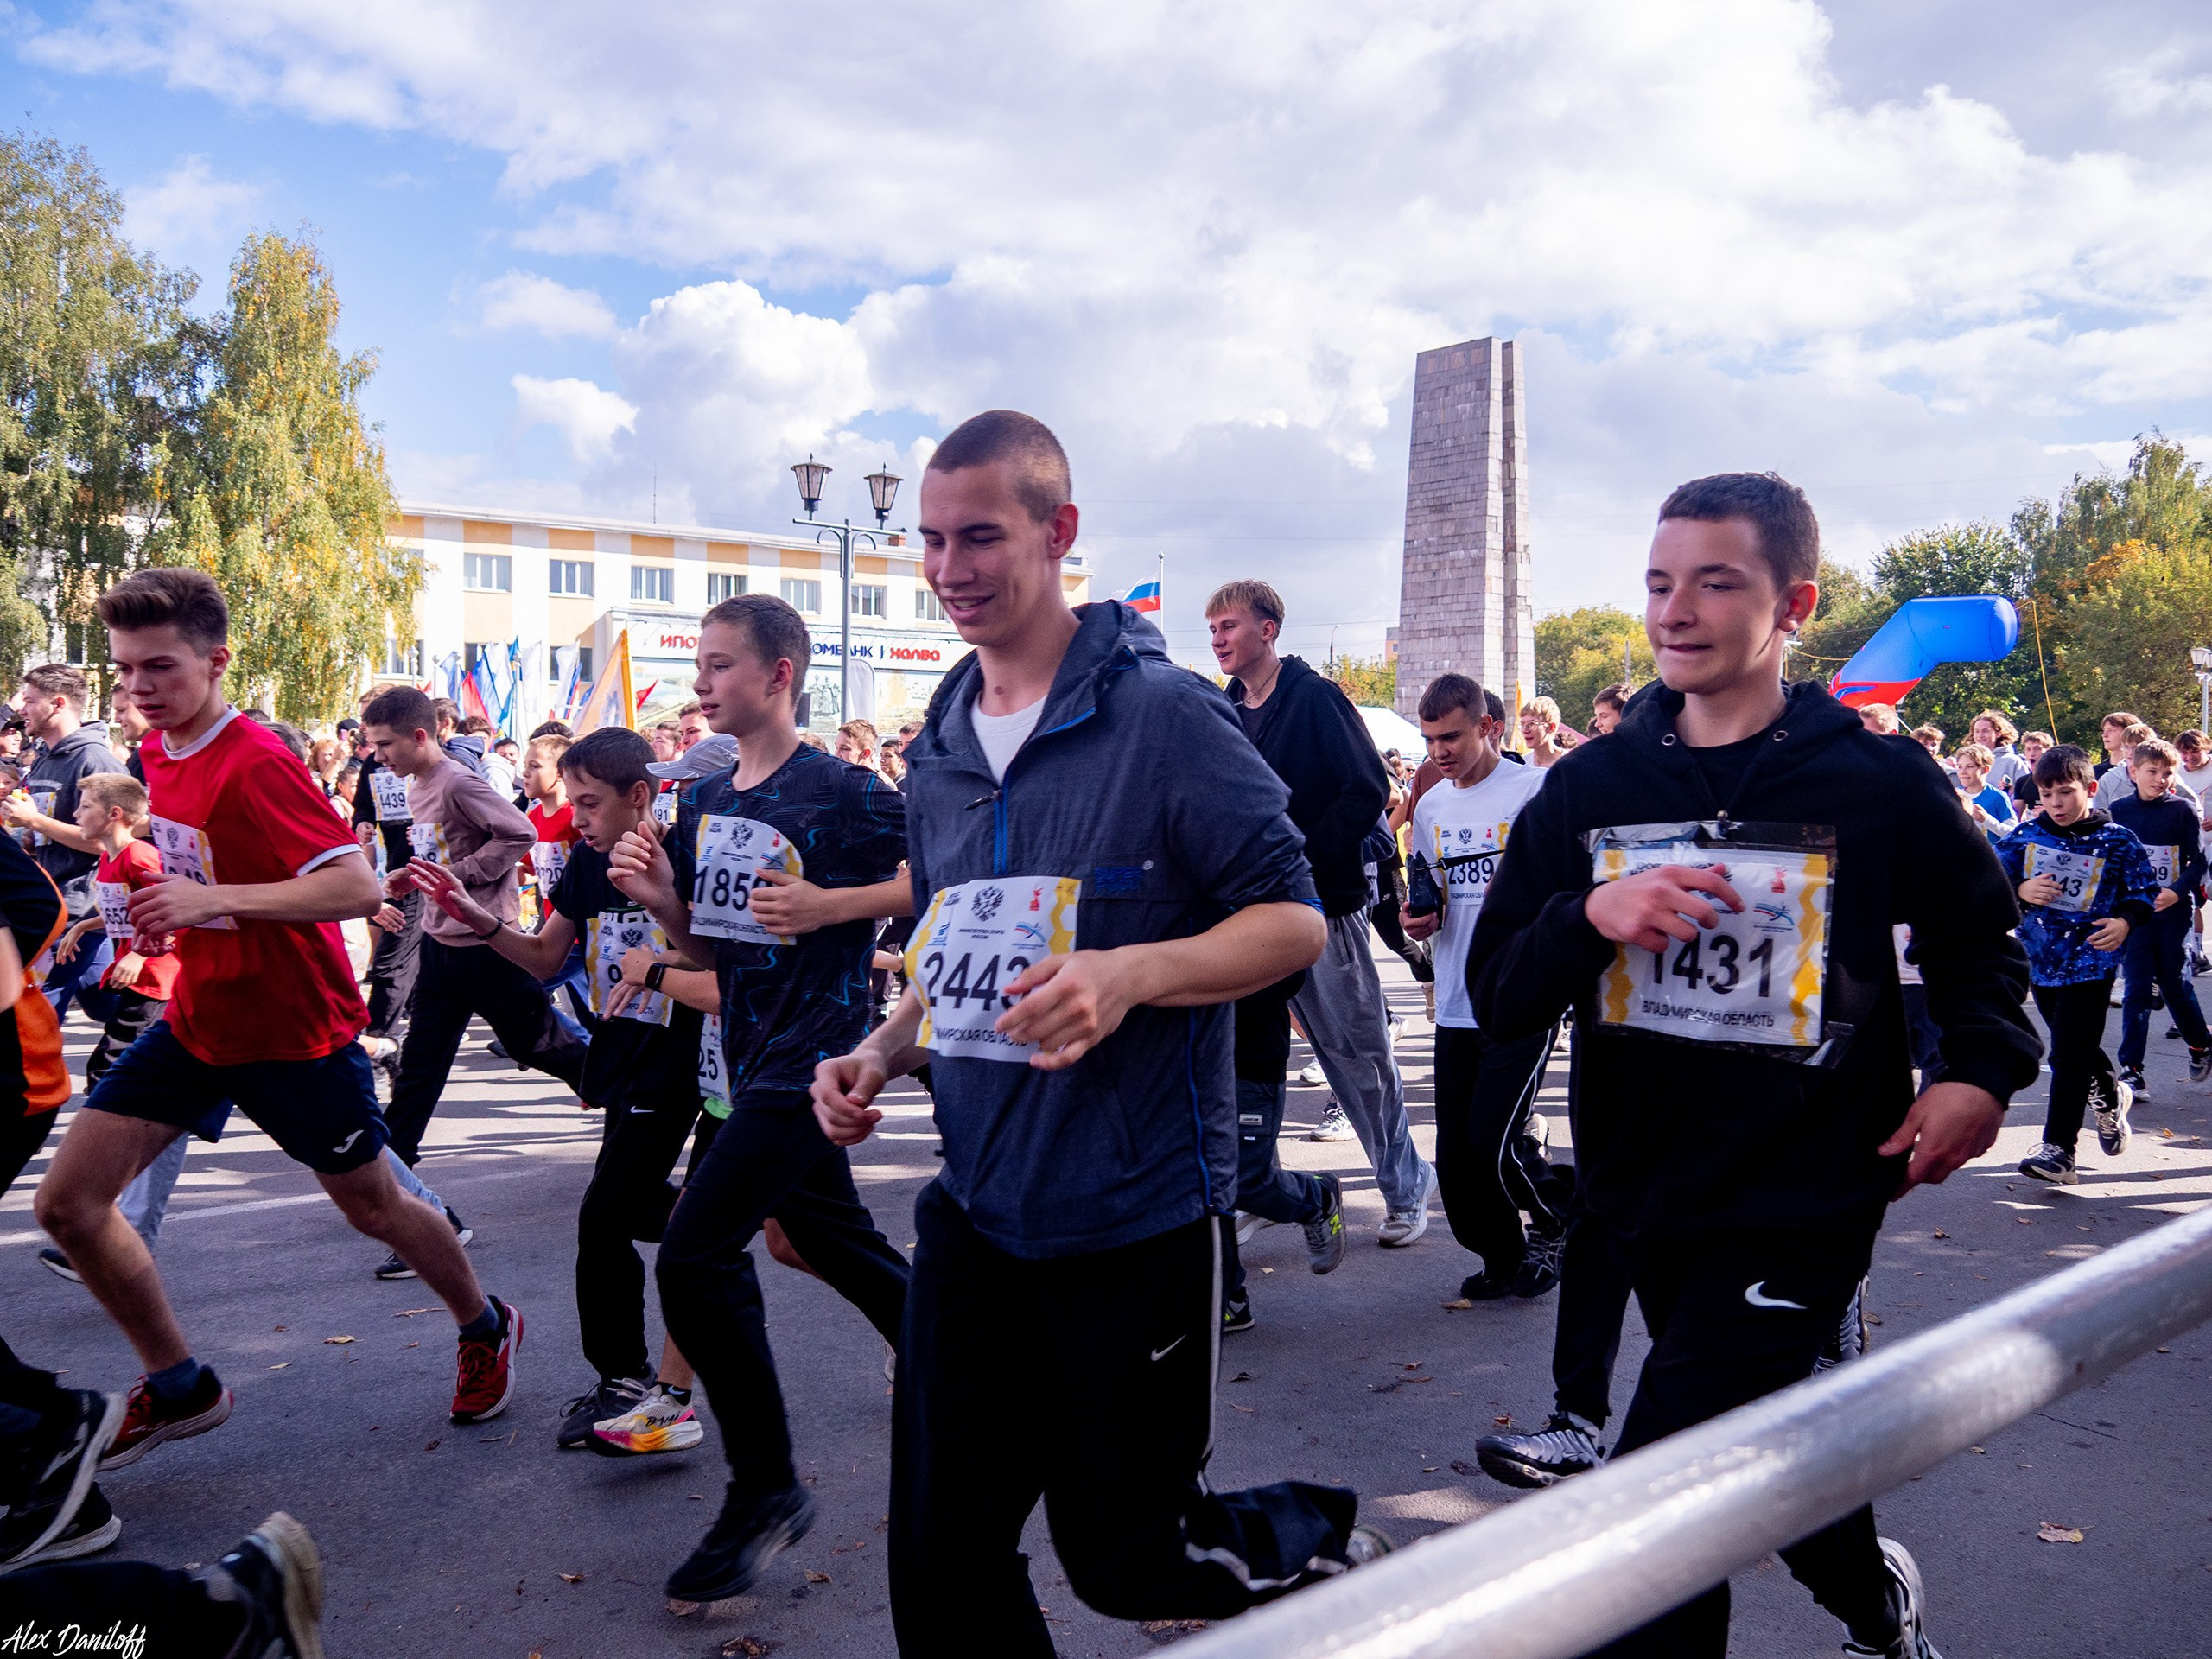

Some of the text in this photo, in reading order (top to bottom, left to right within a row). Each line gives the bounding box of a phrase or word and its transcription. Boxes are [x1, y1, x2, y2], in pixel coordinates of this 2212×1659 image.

[660, 635, 700, 648] ИПО
[1449, 858, 1495, 884] 2389
[924, 951, 1031, 1011] 2443
[1654, 932, 1773, 997] 1431
